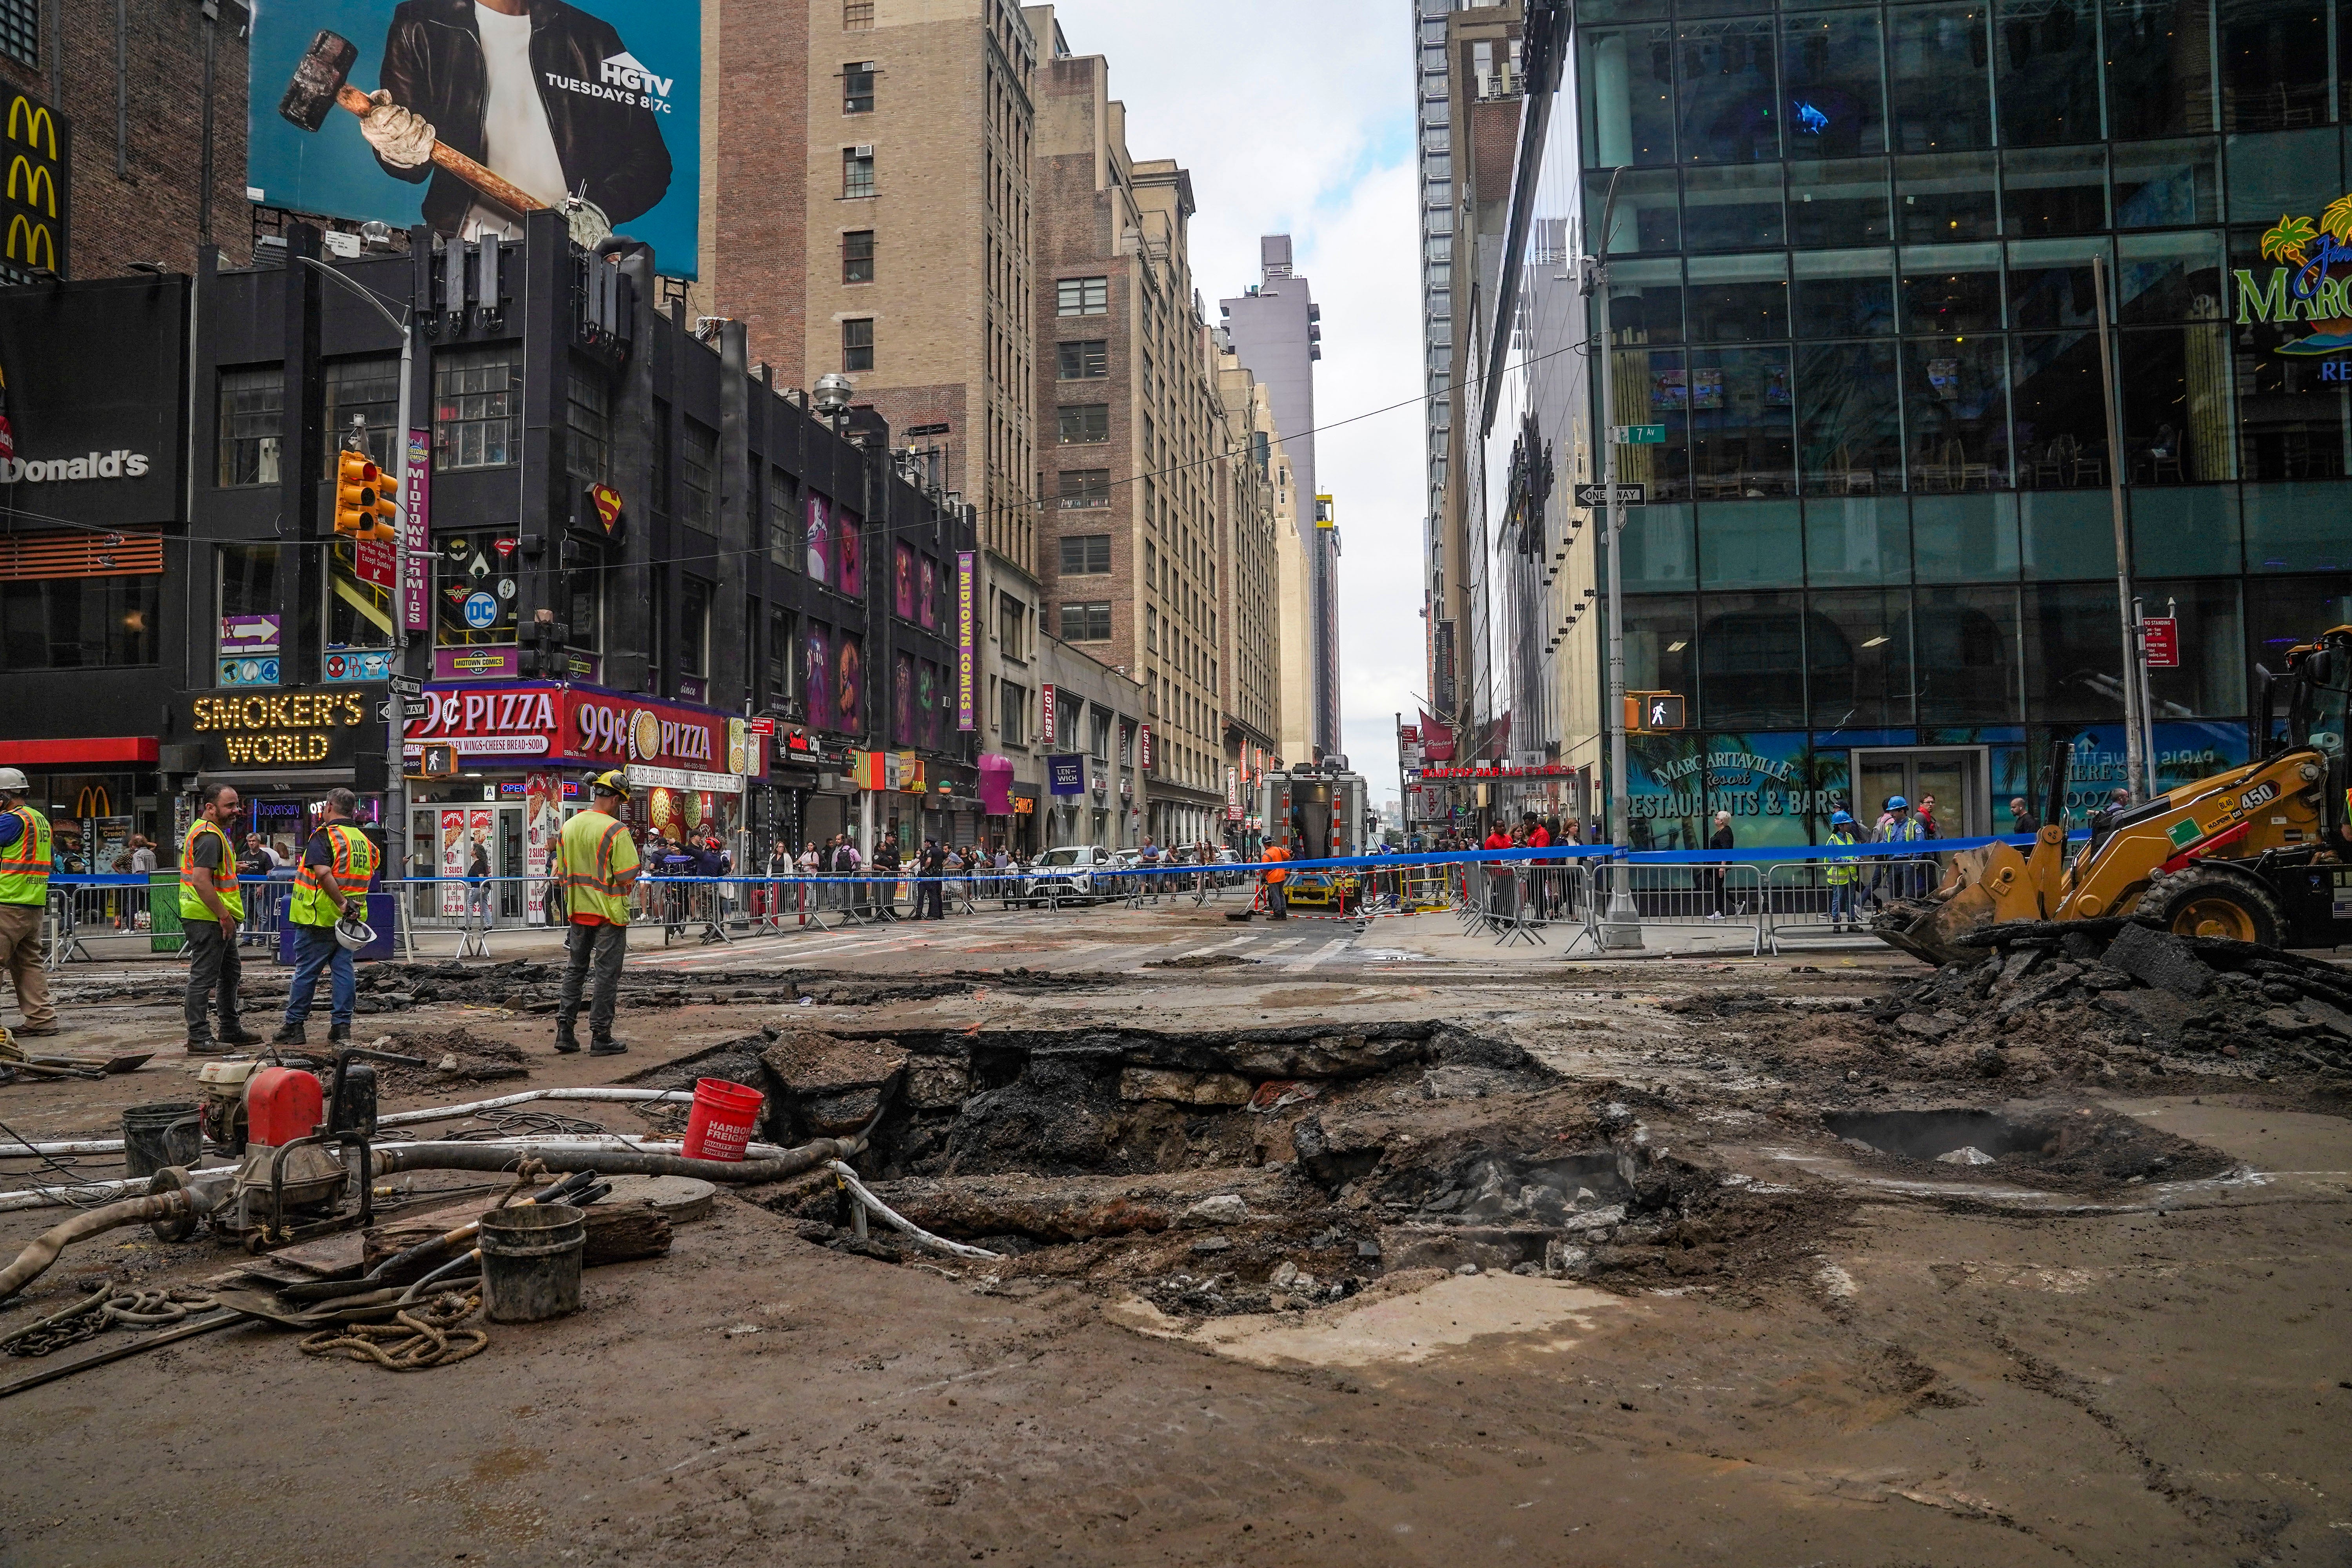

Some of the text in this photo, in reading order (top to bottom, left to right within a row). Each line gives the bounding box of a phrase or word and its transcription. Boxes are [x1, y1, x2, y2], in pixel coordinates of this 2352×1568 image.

[601, 62, 673, 97] HGTV
[546, 73, 635, 105] TUESDAYS
[1637, 428, 1655, 441] 7 Av
[1586, 490, 1636, 500] ONE WAY
[407, 468, 424, 547] MIDTOWN
[358, 543, 396, 562] 7am-9am 4pm-7pm
[372, 540, 389, 553] Standing
[362, 554, 391, 571] Except Sunday
[468, 601, 493, 620] DC
[960, 572, 971, 647] MIDTOWN
[393, 680, 418, 692] ONE WAY
[681, 682, 696, 696] since
[960, 653, 971, 710] COMICS
[193, 691, 363, 731] SMOKER'S
[405, 705, 421, 714] WAY
[464, 693, 557, 731] PIZZA
[1044, 690, 1053, 738] LOT-LESS
[580, 704, 712, 760] 99¢ PIZZA
[630, 709, 642, 756] DELICIOUS
[225, 734, 329, 763] WORLD
[464, 739, 543, 751] WINGS CHEESE BREAD SODA
[789, 731, 820, 755] Smoke City
[1422, 768, 1473, 778] ROOFTOP
[1475, 767, 1499, 777] BAR
[1651, 752, 1795, 787] MARGARITAVILLE
[627, 766, 636, 782] PIZZA
[637, 767, 648, 783] PASTA
[649, 769, 662, 784] CHICKEN
[663, 770, 673, 785] WINGS
[675, 771, 686, 786] GARLIC
[686, 772, 696, 787] KNOTS
[697, 773, 708, 788] CHEESE
[708, 775, 717, 789] BREAD
[725, 777, 733, 790] PATTY
[1702, 771, 1751, 786] Resort
[486, 787, 493, 796] A
[563, 784, 576, 793] PEN
[2241, 784, 2274, 809] 450
[259, 800, 299, 818] Dispensary
[1425, 788, 1437, 815] jacks.
[1626, 789, 1842, 819] RESTAURANTS & BARS
[2219, 799, 2233, 810] BL46
[443, 813, 464, 825] Special
[2232, 809, 2242, 818] CAT
[2207, 815, 2231, 829] H.O.PENN
[83, 821, 91, 840] BIG
[351, 839, 366, 853] NYC
[529, 848, 545, 858] 2 SLICE
[353, 855, 367, 868] DEP
[708, 1120, 751, 1135] HARBOR
[706, 1129, 749, 1143] FREIGHT
[703, 1147, 726, 1157] LOWEST
[705, 1140, 730, 1150] QUALITY
